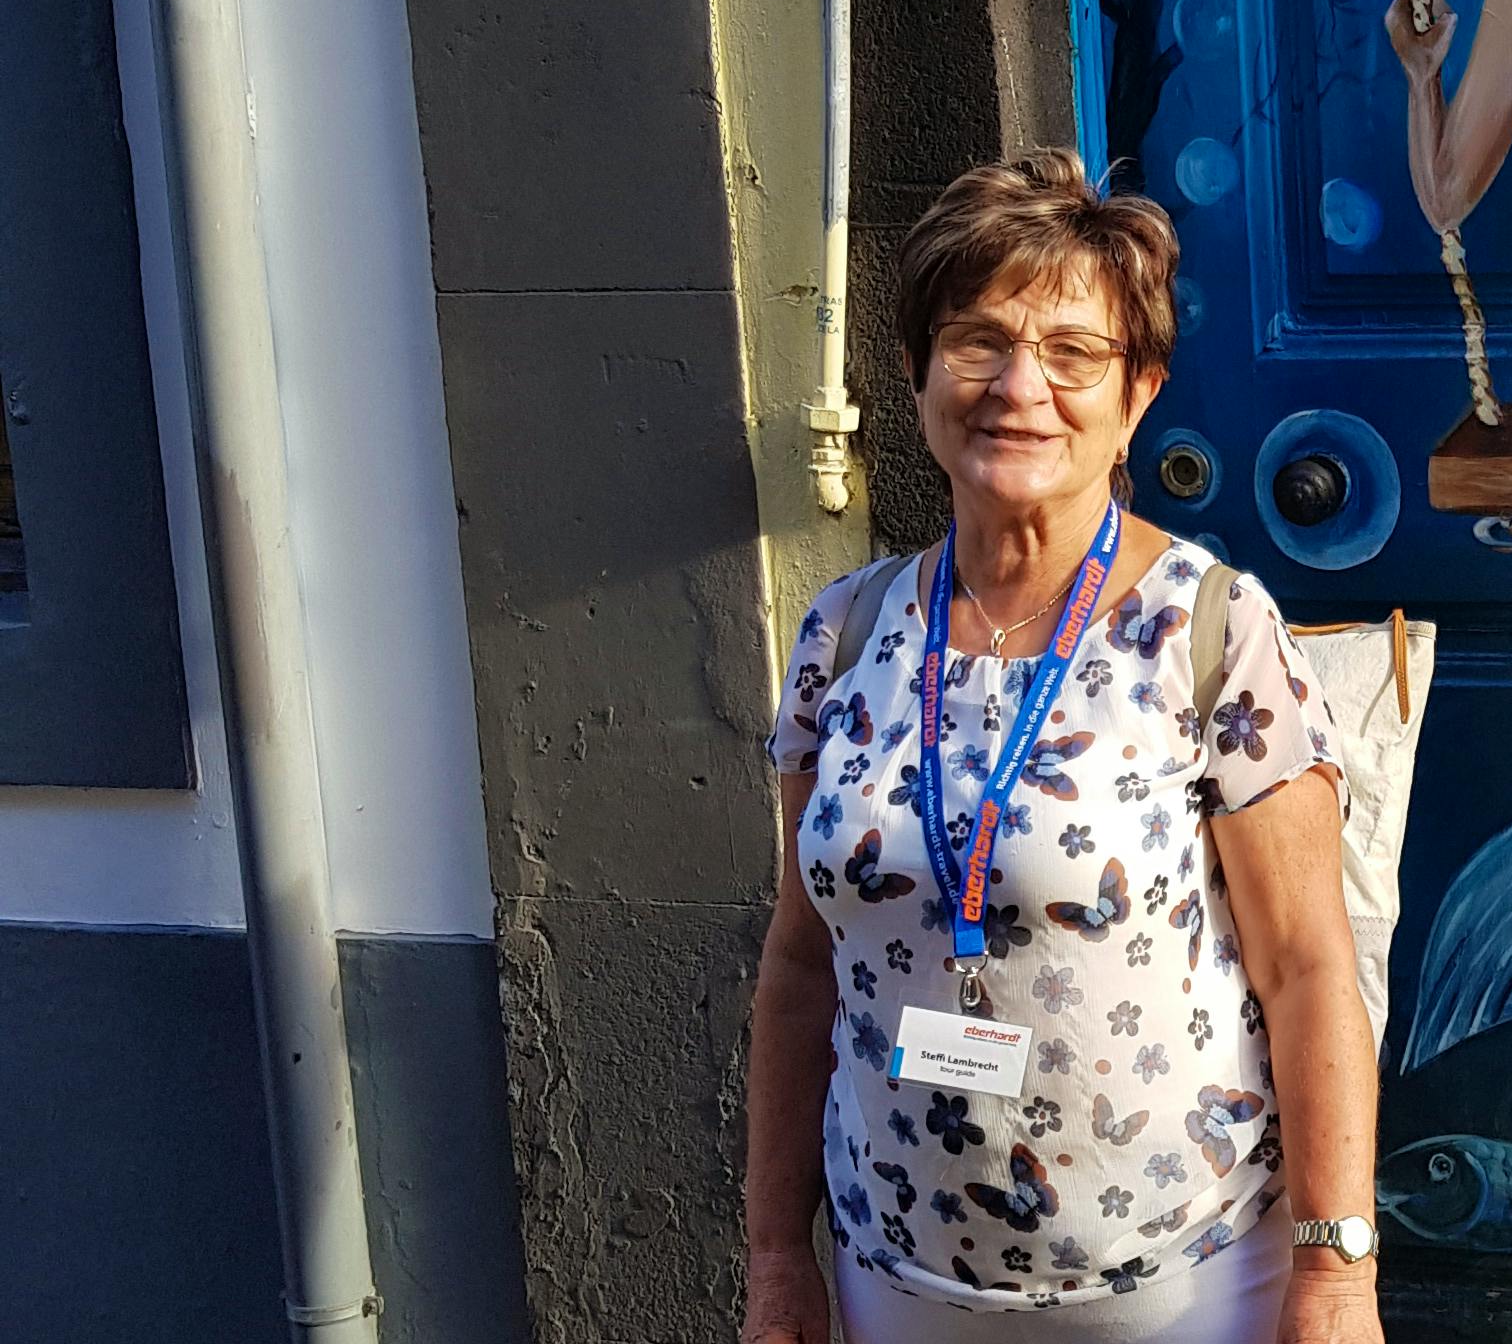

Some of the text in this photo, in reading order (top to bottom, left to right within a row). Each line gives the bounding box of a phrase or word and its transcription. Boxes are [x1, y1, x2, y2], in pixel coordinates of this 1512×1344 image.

[1056, 557, 1105, 660] eberhardt
[924, 652, 939, 748] eberhardt
[996, 758, 1018, 790] Richtig
[961, 799, 1001, 922] eberhardt
[920, 1050, 999, 1072] Steffi Lambrecht
[964, 1026, 1021, 1042] eberhardt
